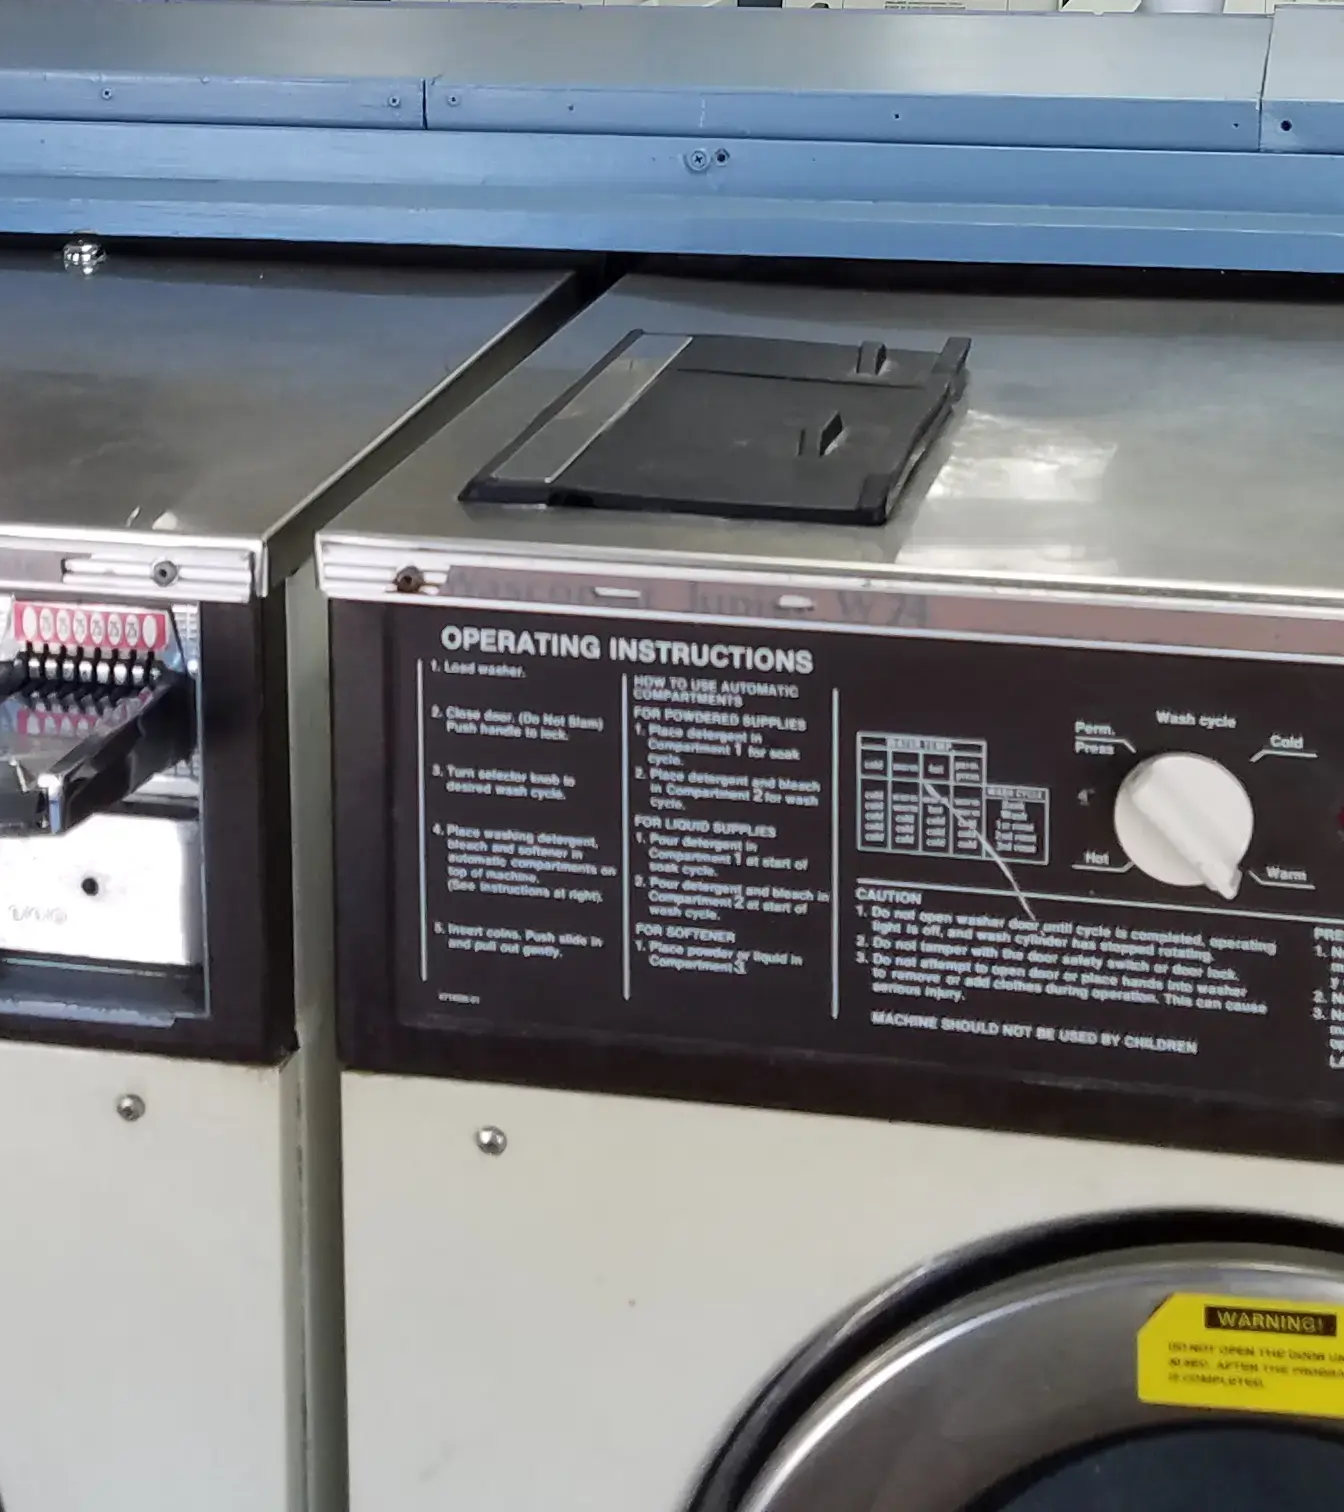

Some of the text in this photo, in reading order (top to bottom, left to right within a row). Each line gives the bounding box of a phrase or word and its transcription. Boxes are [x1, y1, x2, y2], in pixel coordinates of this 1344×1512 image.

[441, 625, 813, 674] OPERATING INSTRUCTIONS
[1217, 1310, 1324, 1333] WARNING!
